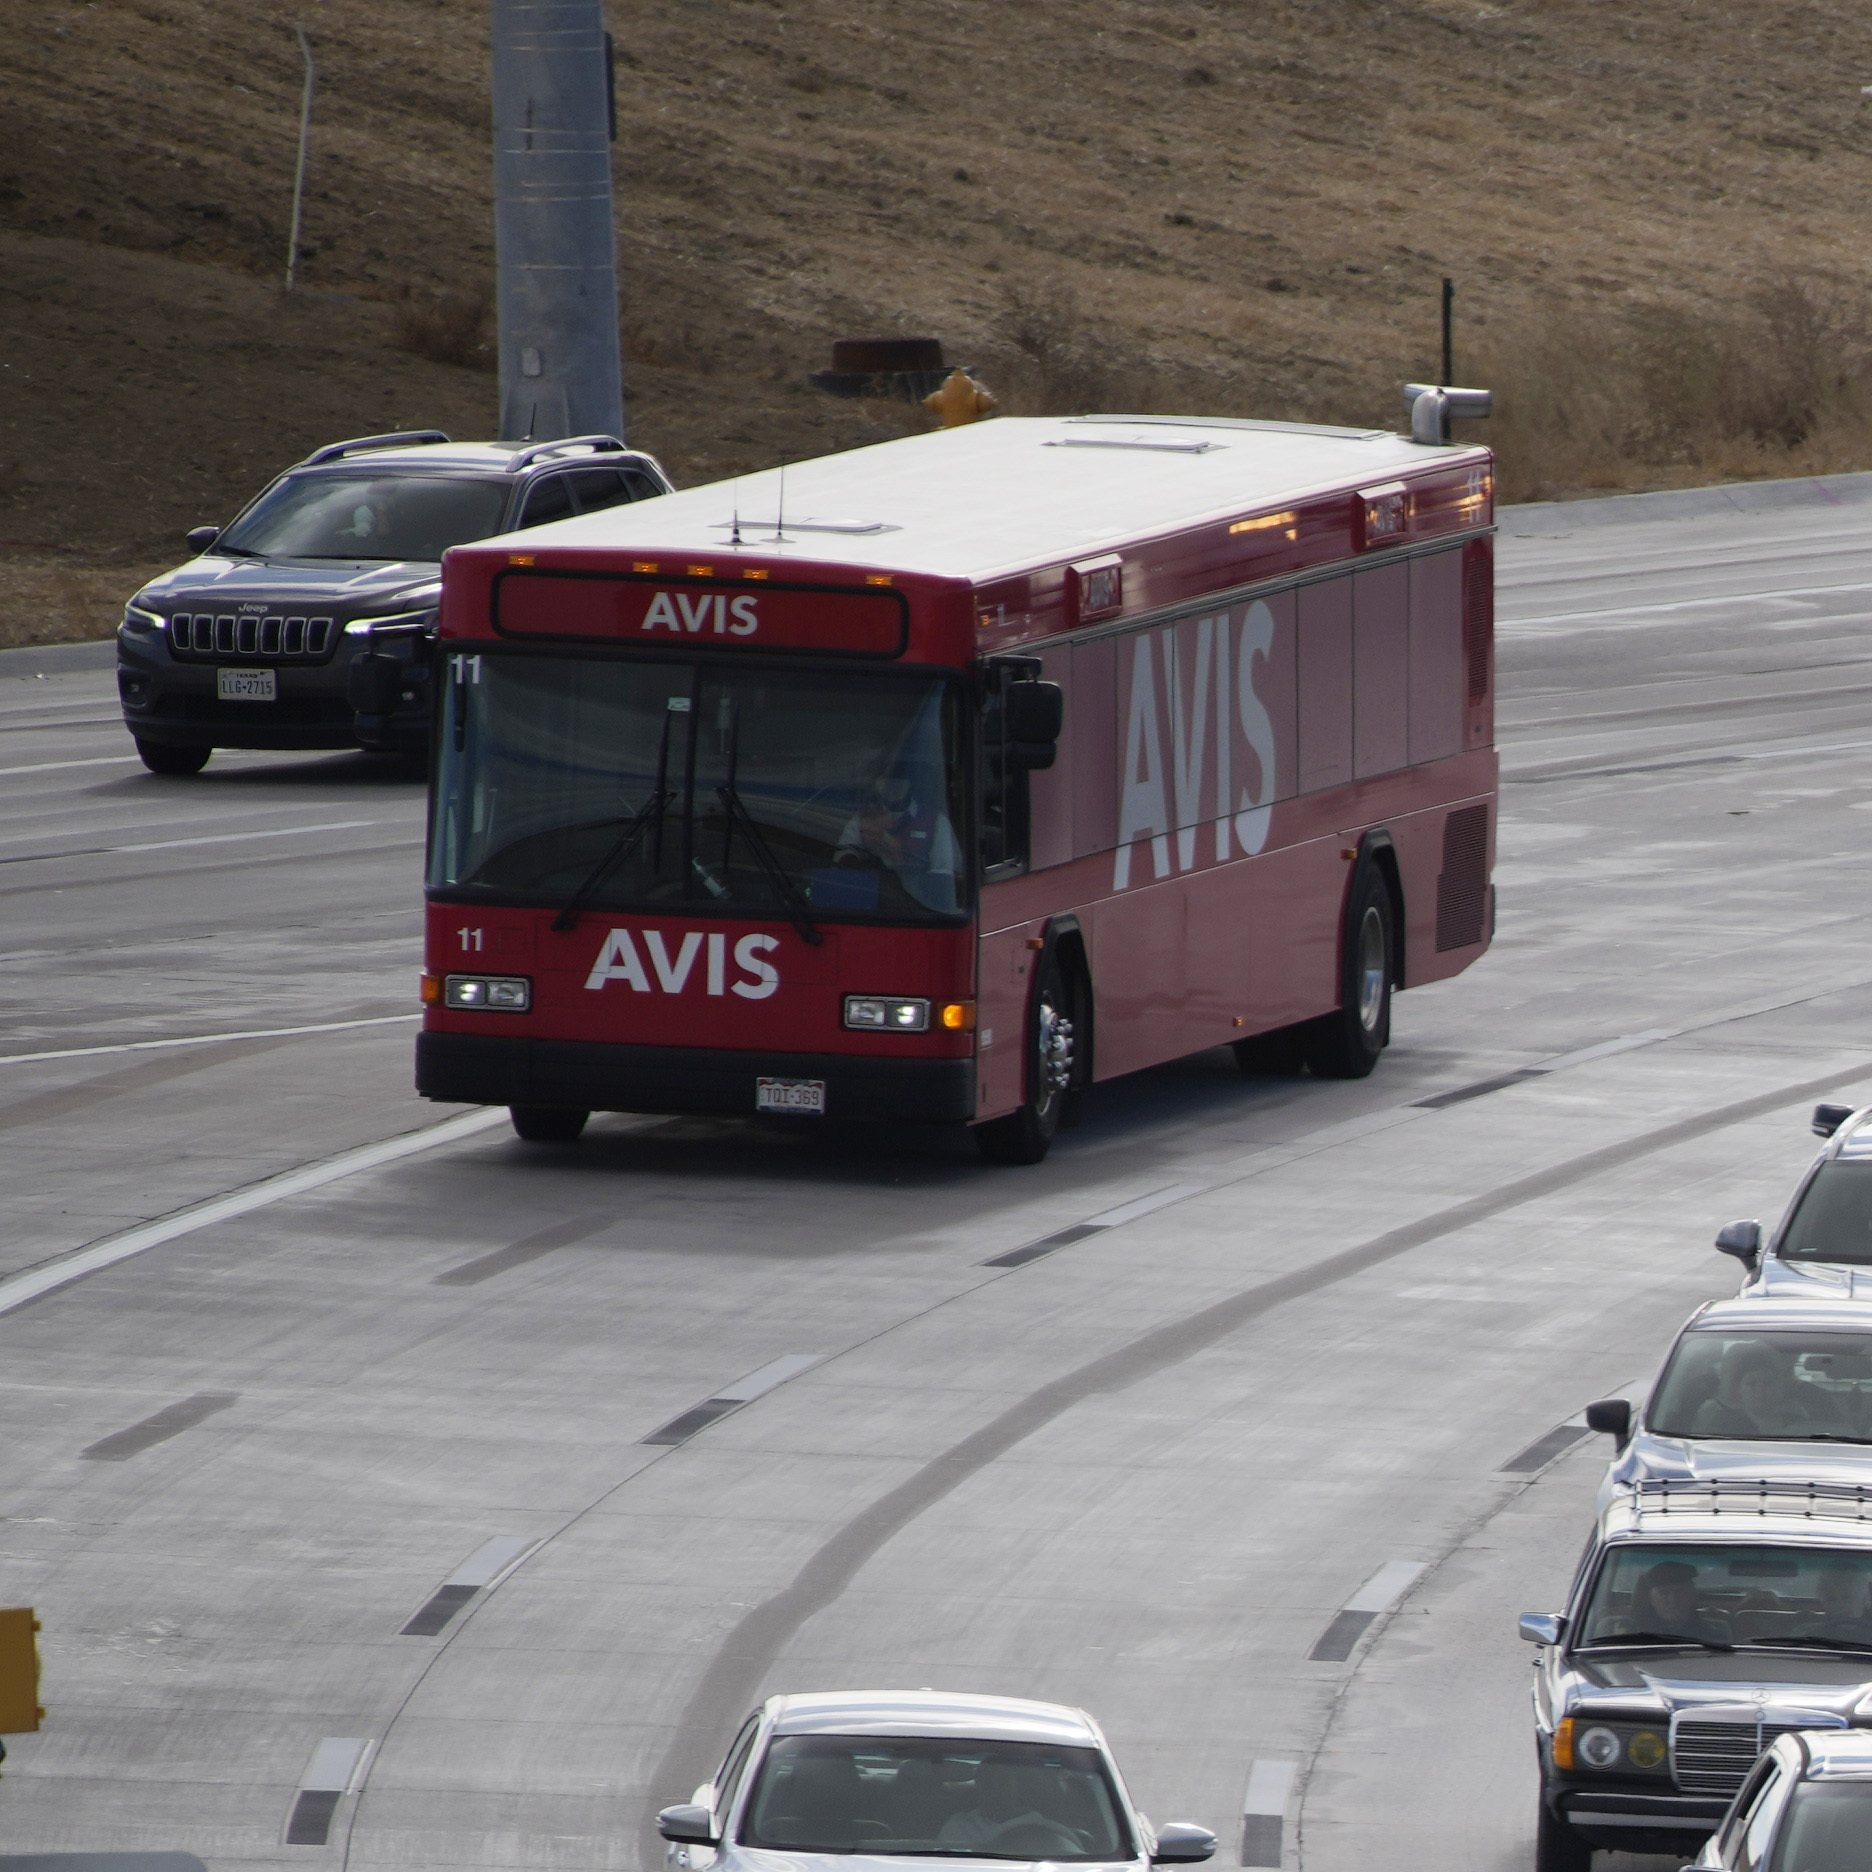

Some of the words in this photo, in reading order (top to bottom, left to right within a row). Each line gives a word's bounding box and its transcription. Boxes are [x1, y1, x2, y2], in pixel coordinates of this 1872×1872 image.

[238, 603, 268, 613] Jeep
[641, 592, 759, 636] AVIS
[451, 654, 481, 684] 11
[1112, 600, 1276, 892] AVIS
[456, 927, 482, 951] 11
[584, 928, 781, 999] AVIS
